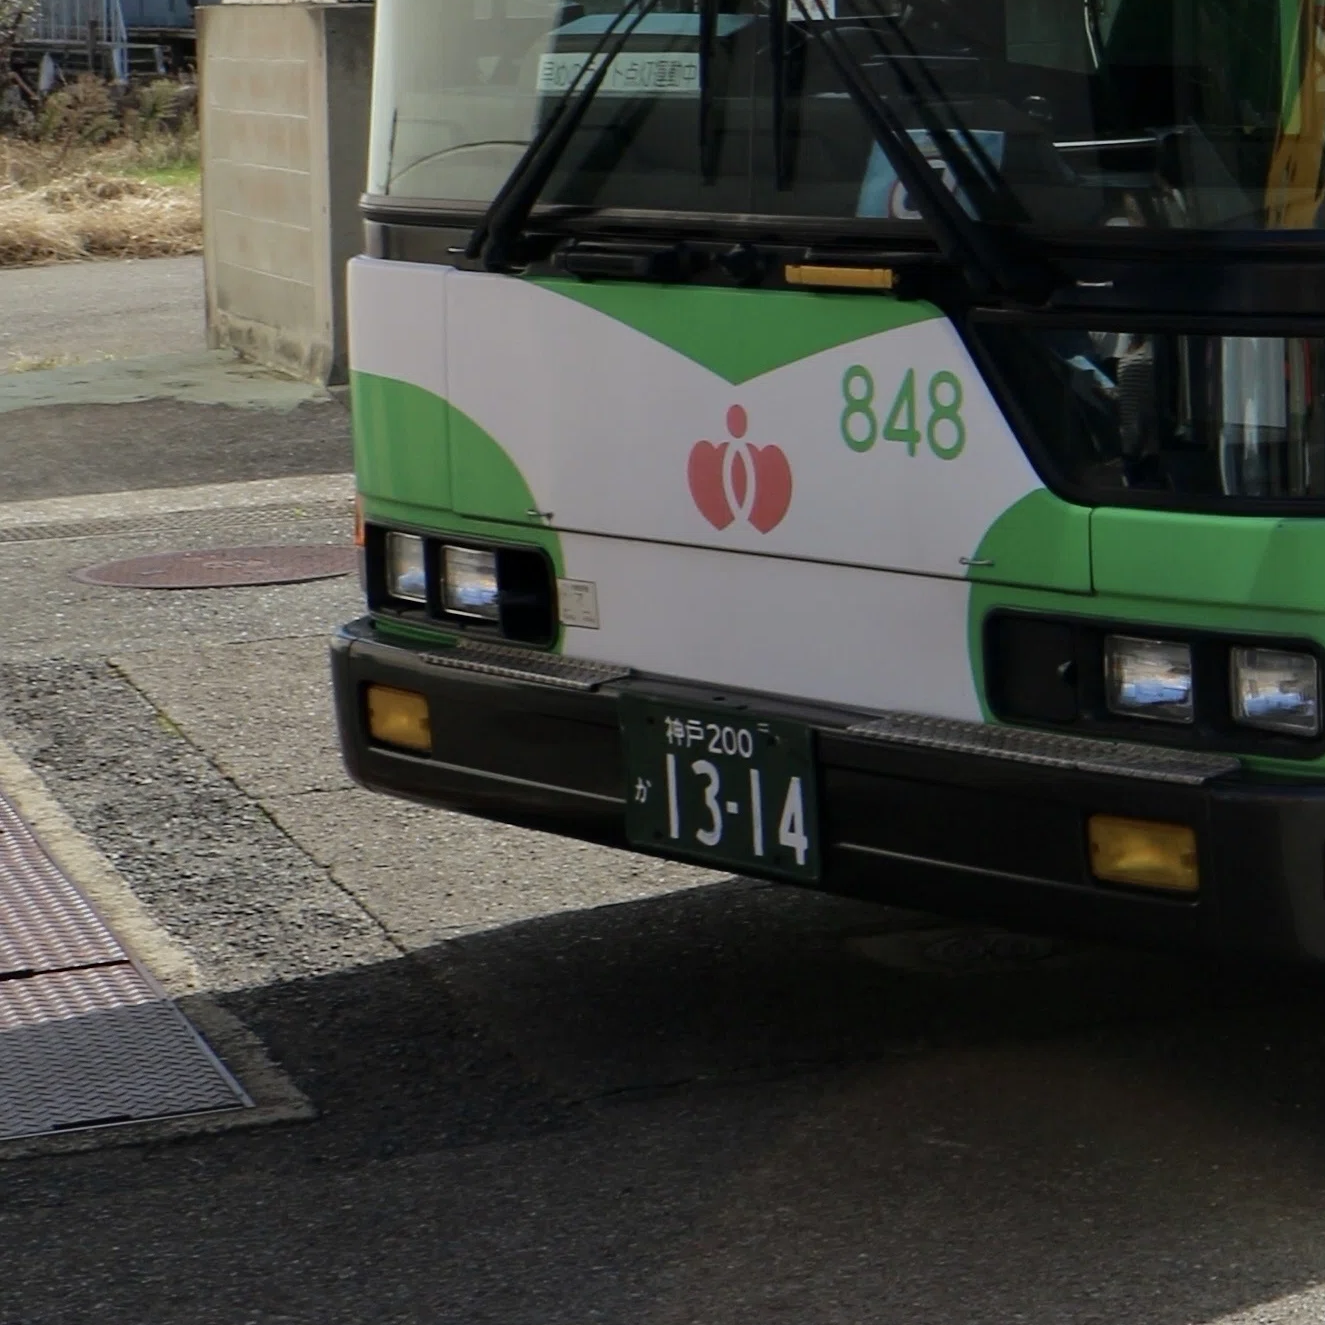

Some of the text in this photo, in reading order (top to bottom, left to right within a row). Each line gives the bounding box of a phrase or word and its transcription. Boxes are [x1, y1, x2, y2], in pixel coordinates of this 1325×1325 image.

[840, 363, 966, 461] 848
[634, 753, 808, 866] か 13-14
